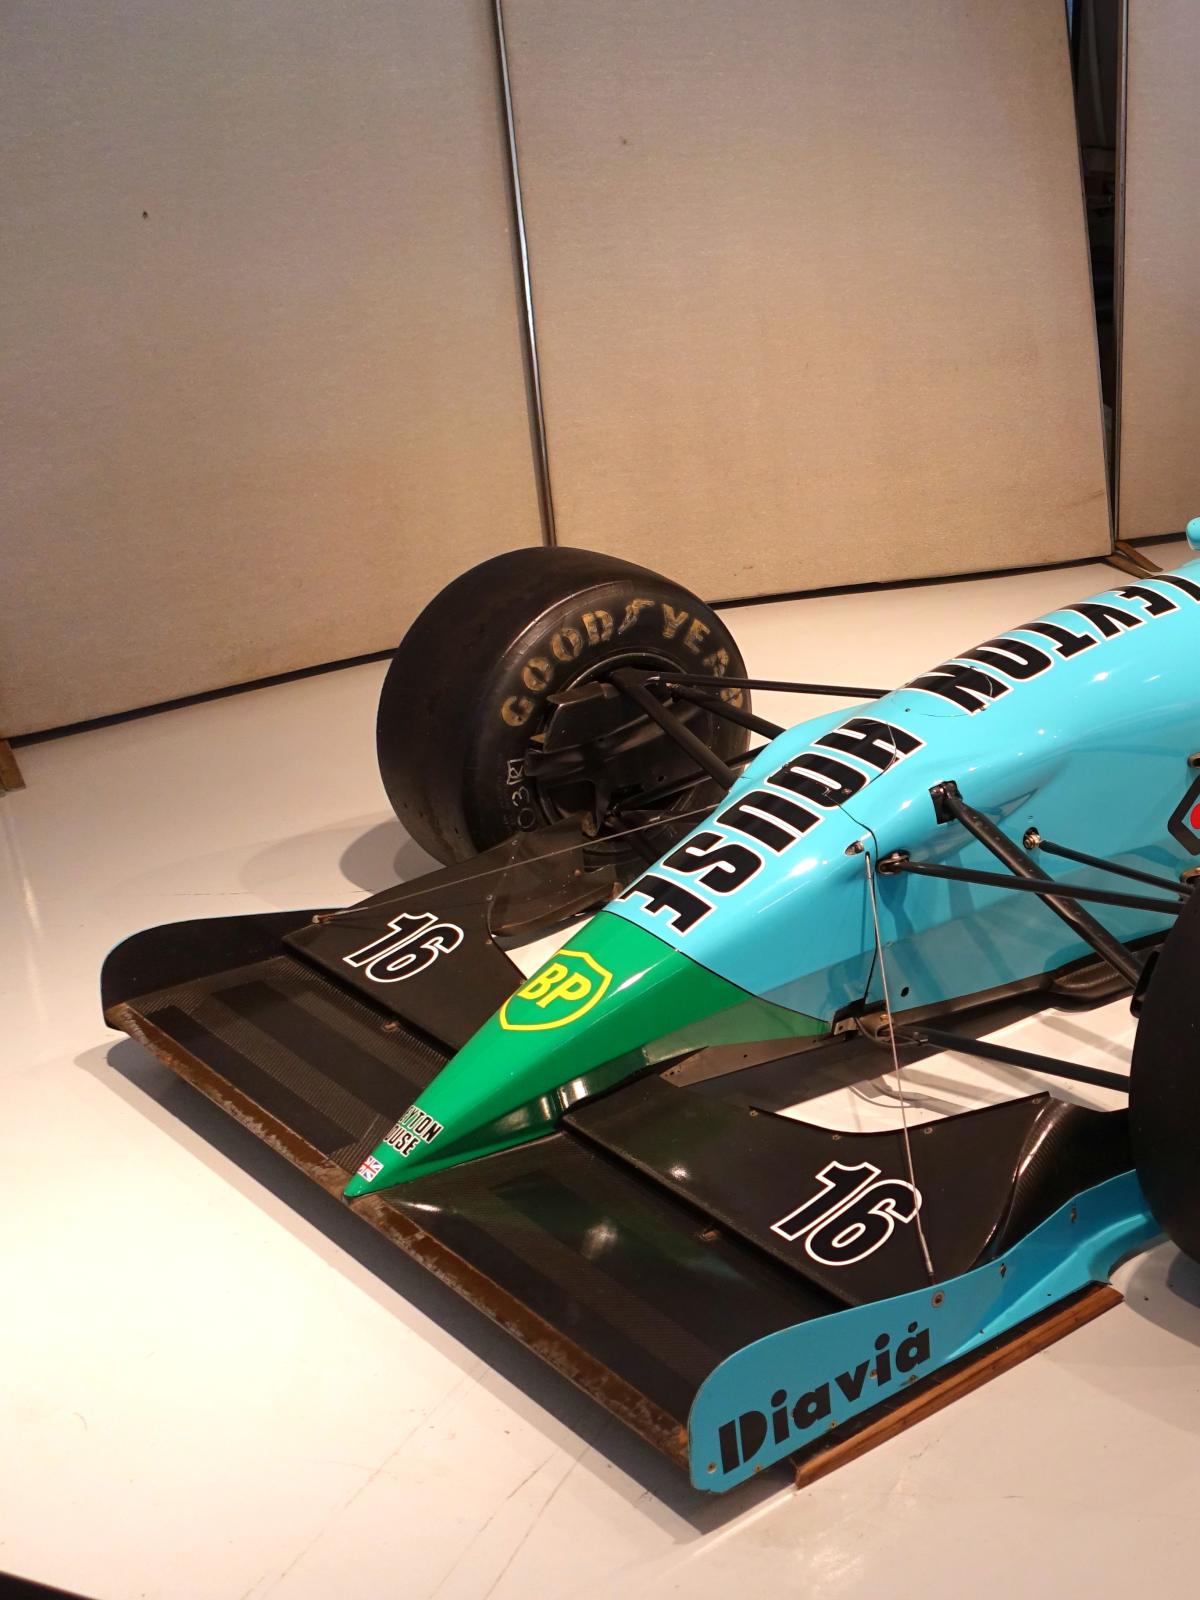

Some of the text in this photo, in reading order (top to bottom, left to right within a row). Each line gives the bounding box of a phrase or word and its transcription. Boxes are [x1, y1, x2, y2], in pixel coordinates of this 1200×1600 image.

[617, 716, 928, 936] HOUSE
[342, 912, 464, 983] 16
[517, 962, 592, 1008] BP
[771, 1160, 922, 1266] 16
